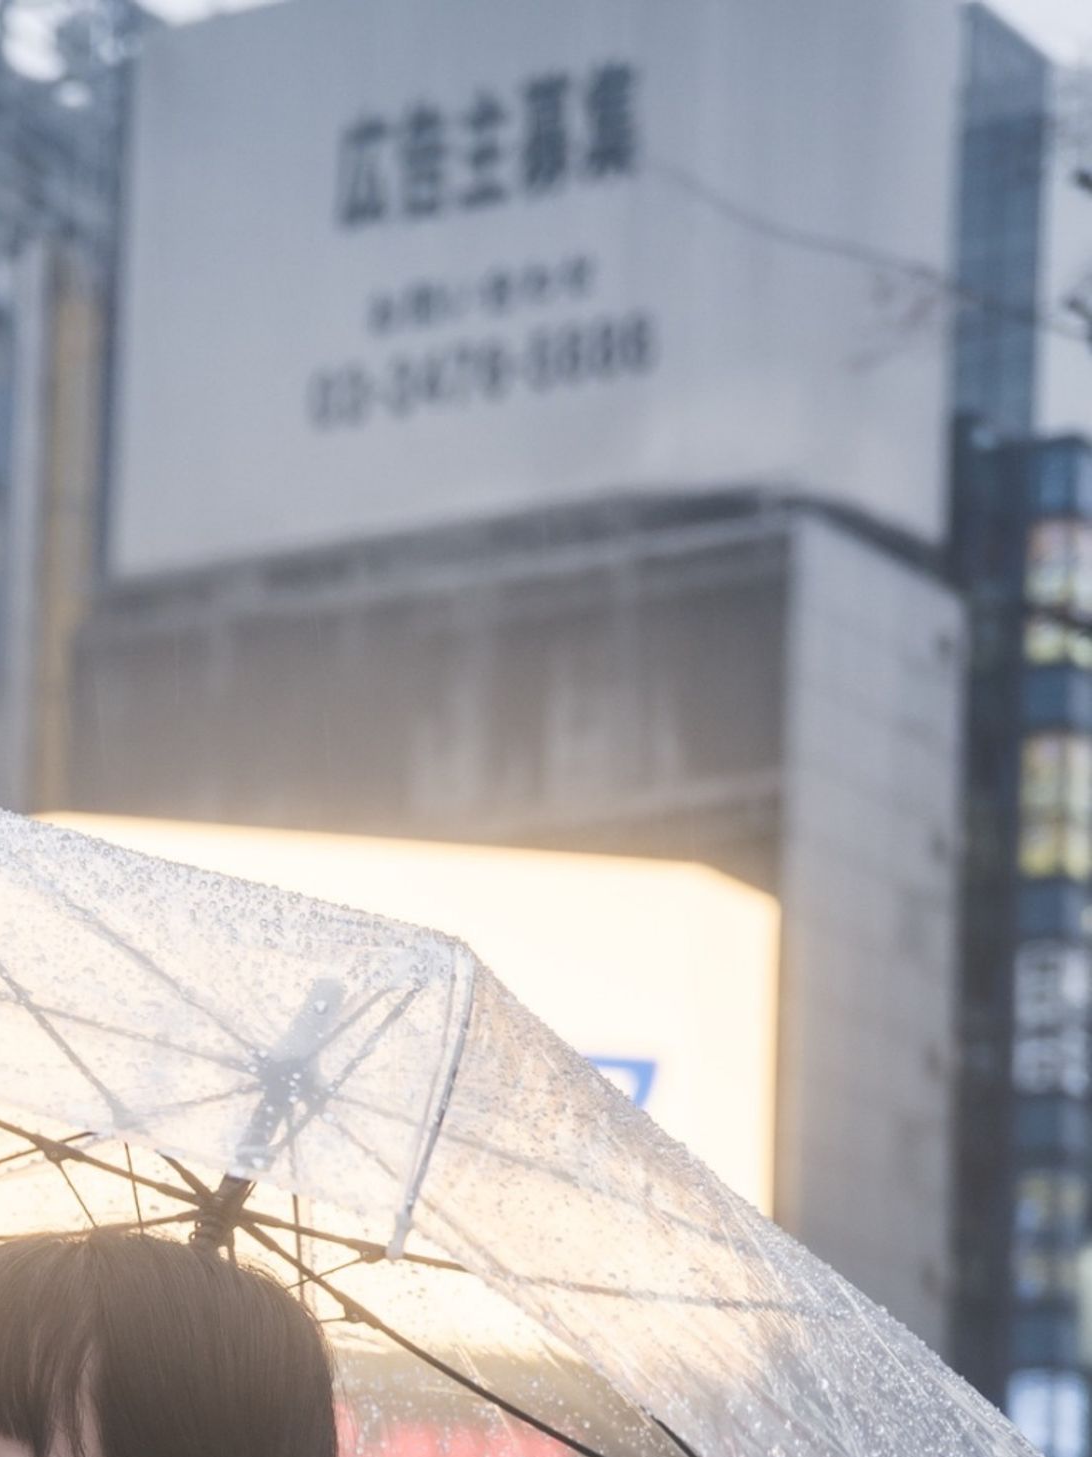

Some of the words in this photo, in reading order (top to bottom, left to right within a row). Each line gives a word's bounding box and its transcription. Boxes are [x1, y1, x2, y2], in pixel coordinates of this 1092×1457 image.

[337, 62, 636, 228] 広告主募集
